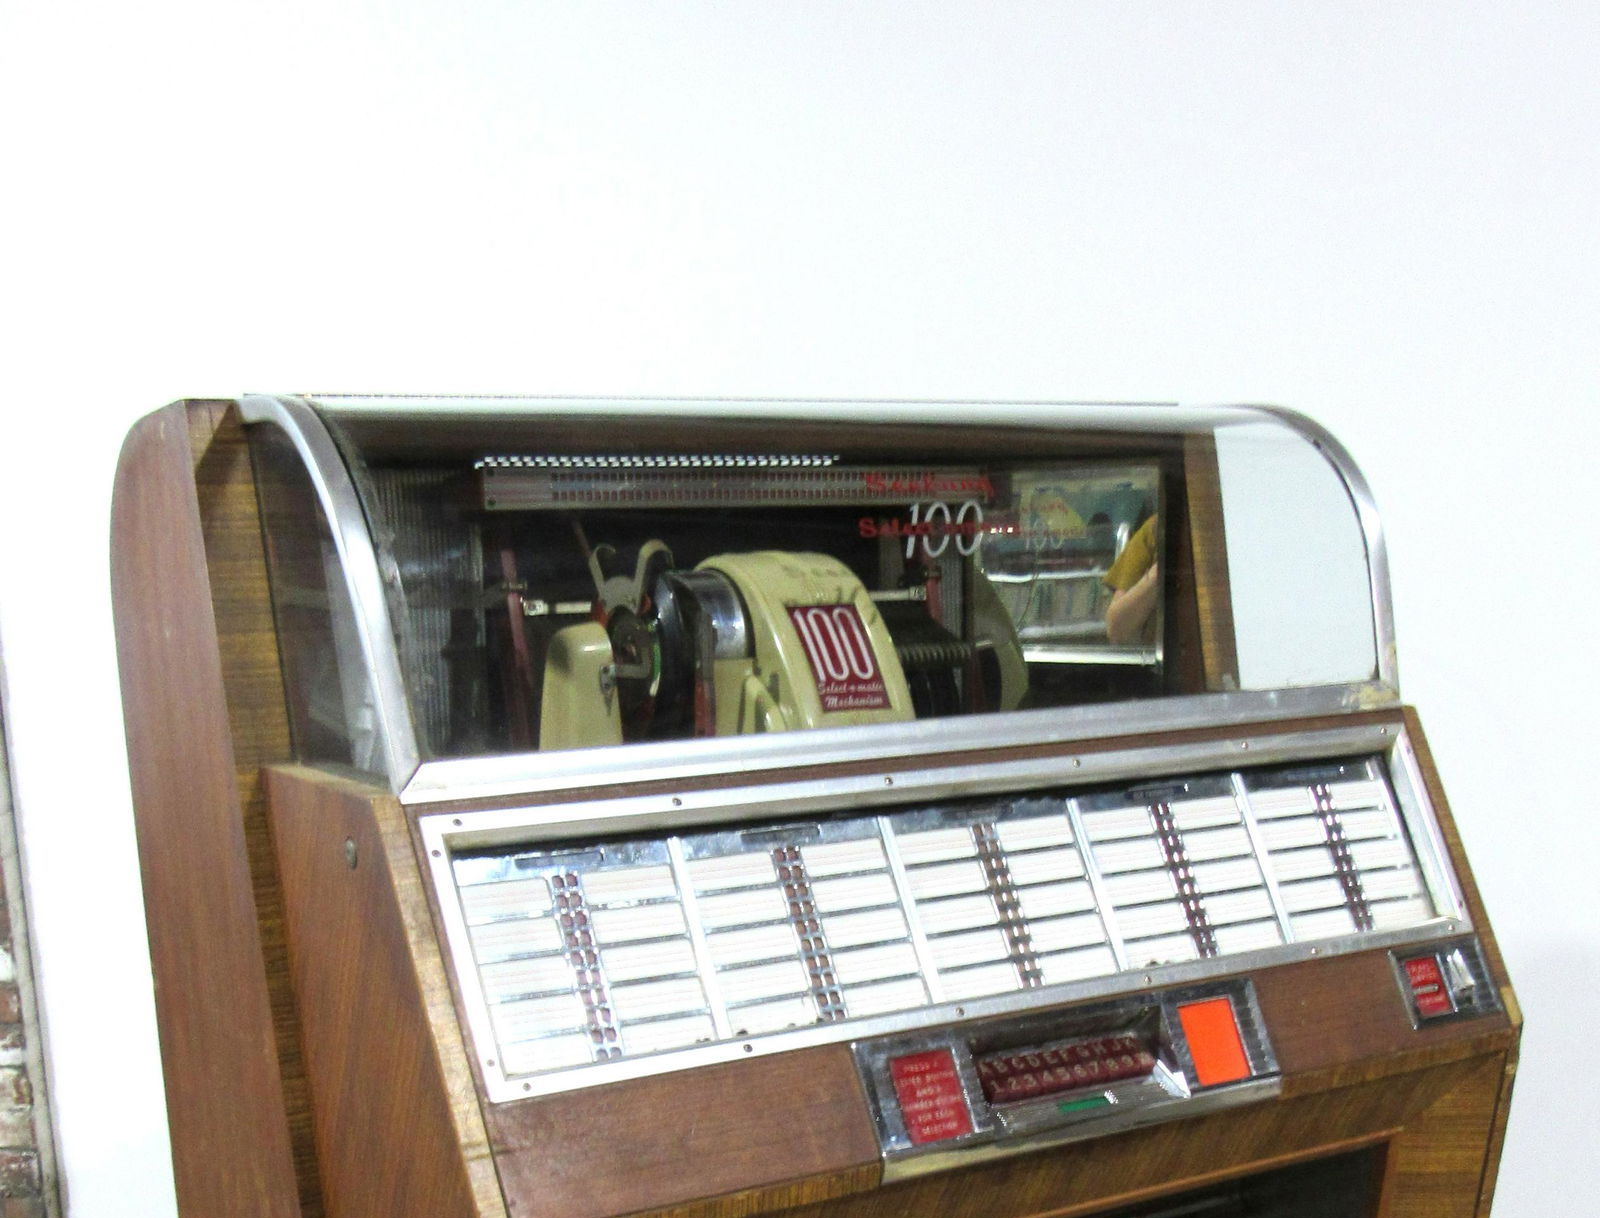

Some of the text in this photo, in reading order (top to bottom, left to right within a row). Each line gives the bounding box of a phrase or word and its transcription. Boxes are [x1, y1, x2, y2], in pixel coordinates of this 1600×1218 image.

[906, 501, 984, 559] 100
[793, 606, 874, 682] 100
[825, 695, 884, 707] Mechanism
